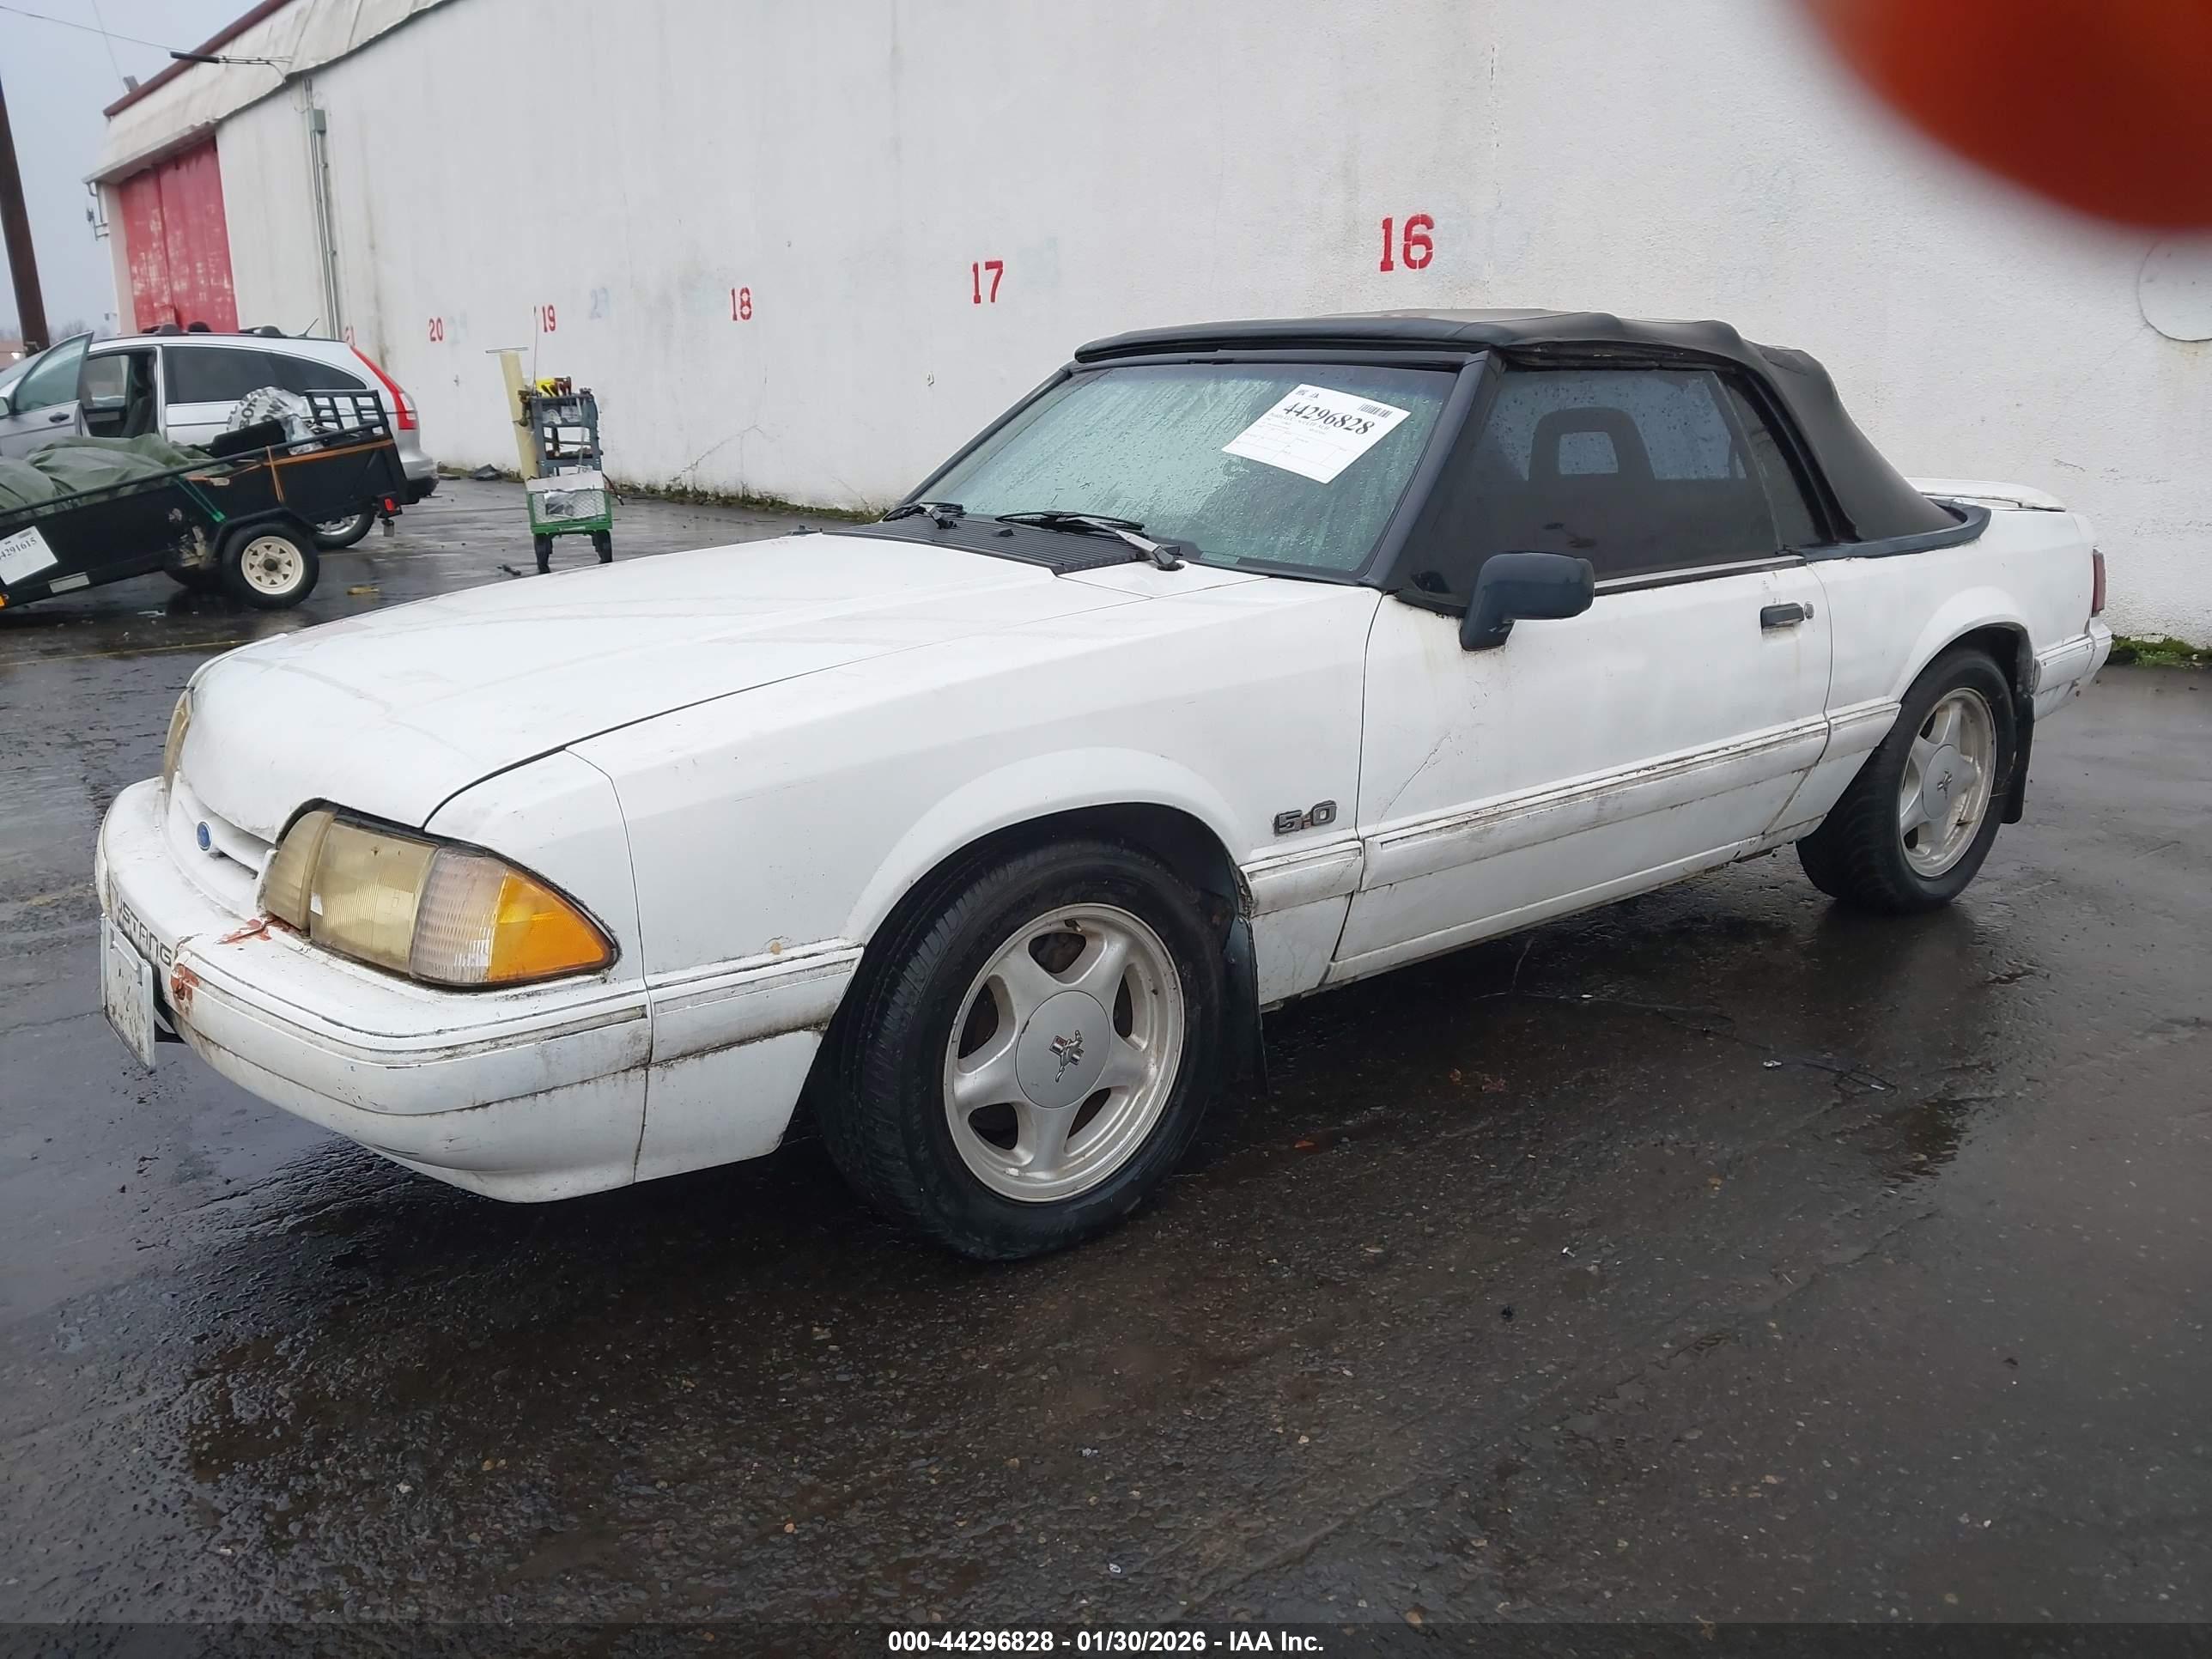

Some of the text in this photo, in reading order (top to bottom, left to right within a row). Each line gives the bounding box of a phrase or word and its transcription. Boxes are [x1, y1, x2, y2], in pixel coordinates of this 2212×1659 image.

[1378, 213, 1435, 273] 16
[971, 259, 1005, 305] 17
[542, 304, 556, 333] 19
[731, 287, 753, 322] 18
[429, 317, 444, 342] 20
[1283, 401, 1376, 435] 44296828
[0, 537, 37, 560] 4291615
[1273, 799, 1337, 836] 5.0
